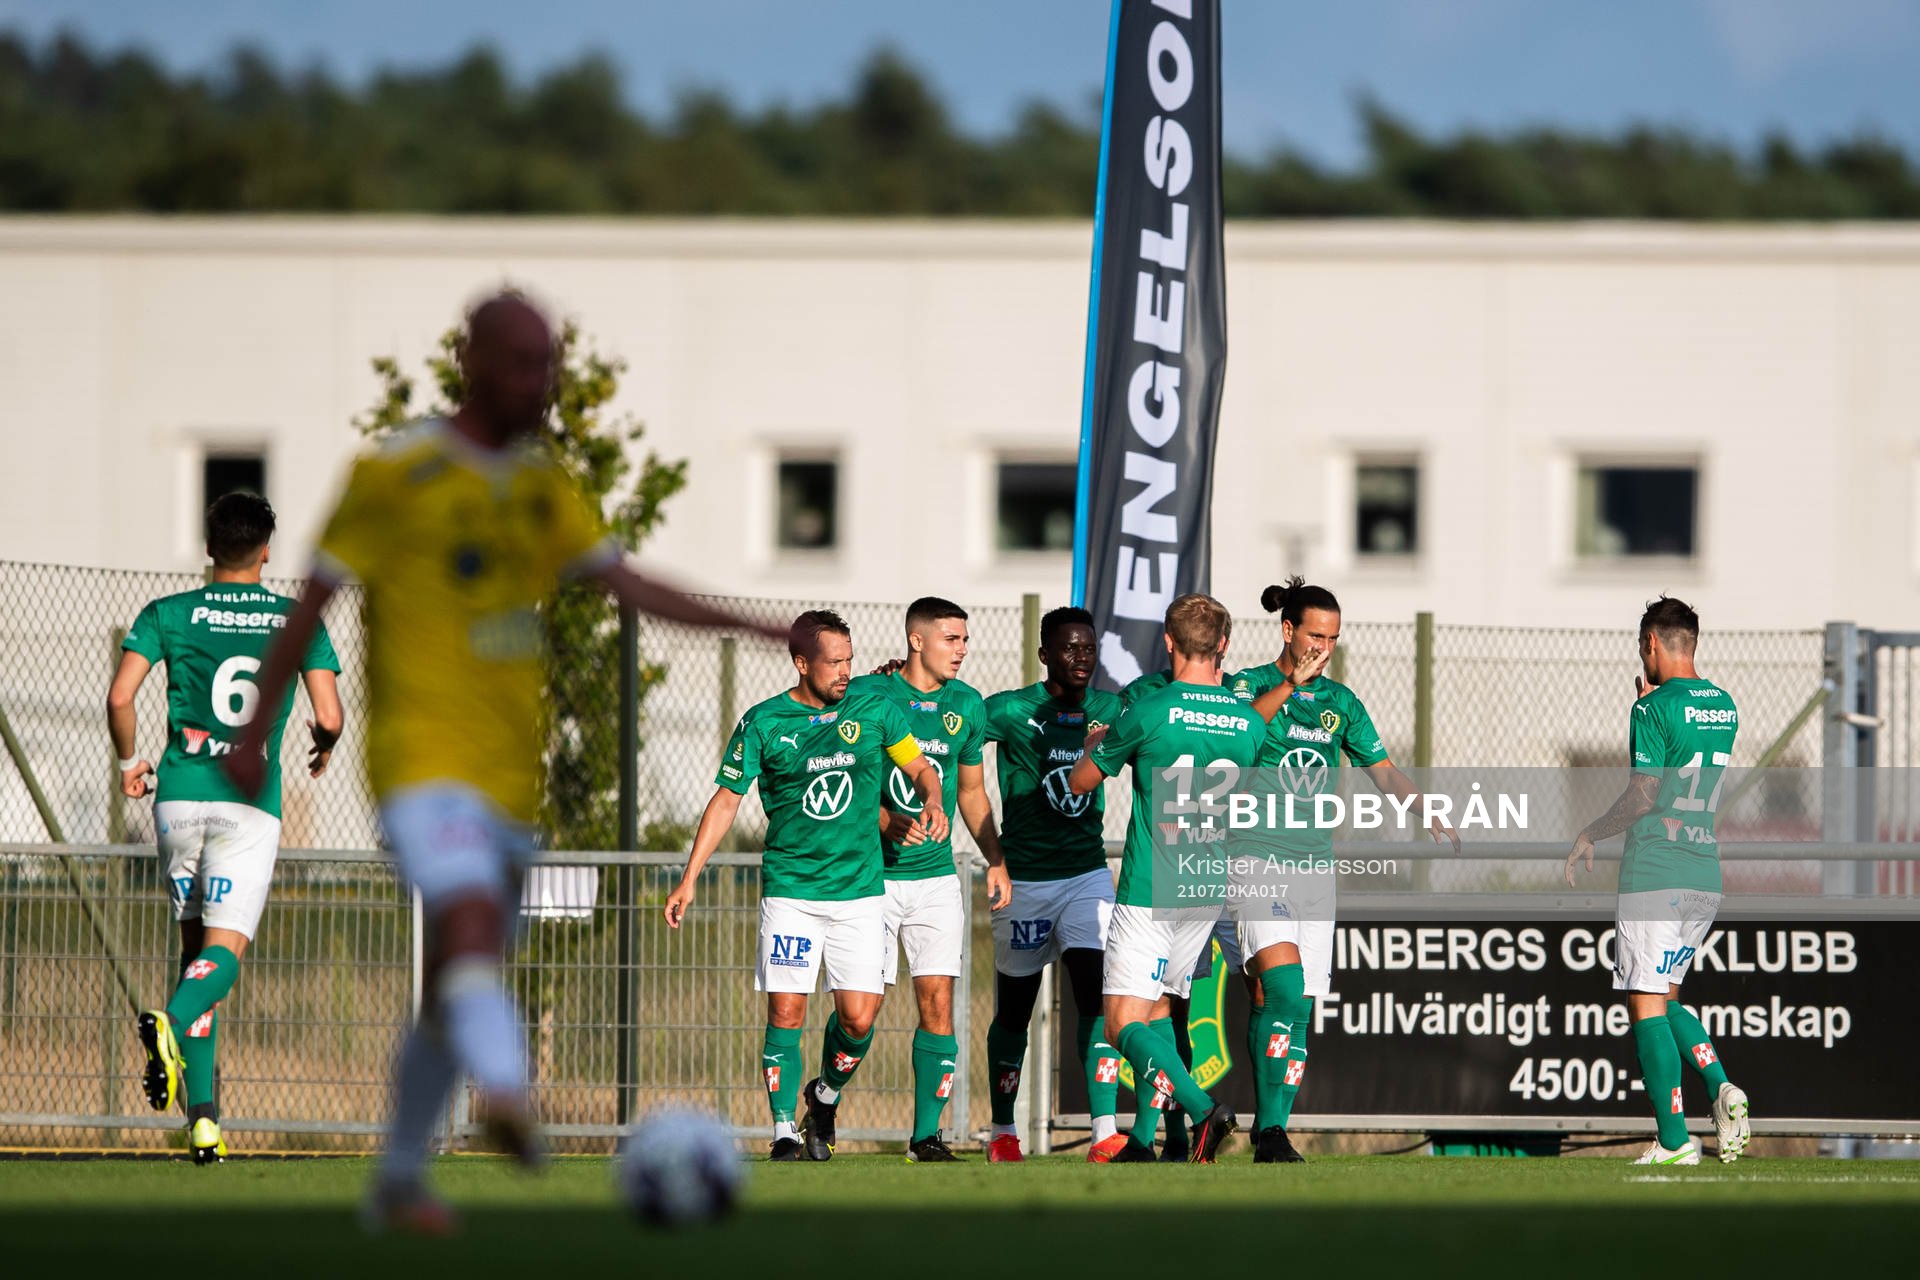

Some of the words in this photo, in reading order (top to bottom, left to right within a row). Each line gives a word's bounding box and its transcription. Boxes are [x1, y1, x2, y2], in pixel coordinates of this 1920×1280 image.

[1114, 0, 1195, 622] ENGELSO
[191, 606, 287, 628] Passera
[211, 655, 262, 728] 6
[1182, 692, 1237, 705] SVENSSON
[1169, 707, 1250, 732] Passera
[1288, 725, 1332, 743] Atteviks
[807, 751, 856, 772] Atteviks
[1161, 754, 1241, 817] 12
[1336, 928, 1547, 971] INBERGS
[1314, 991, 1551, 1047] Fullvärdigt
[1509, 1057, 1646, 1101] 4500:-
